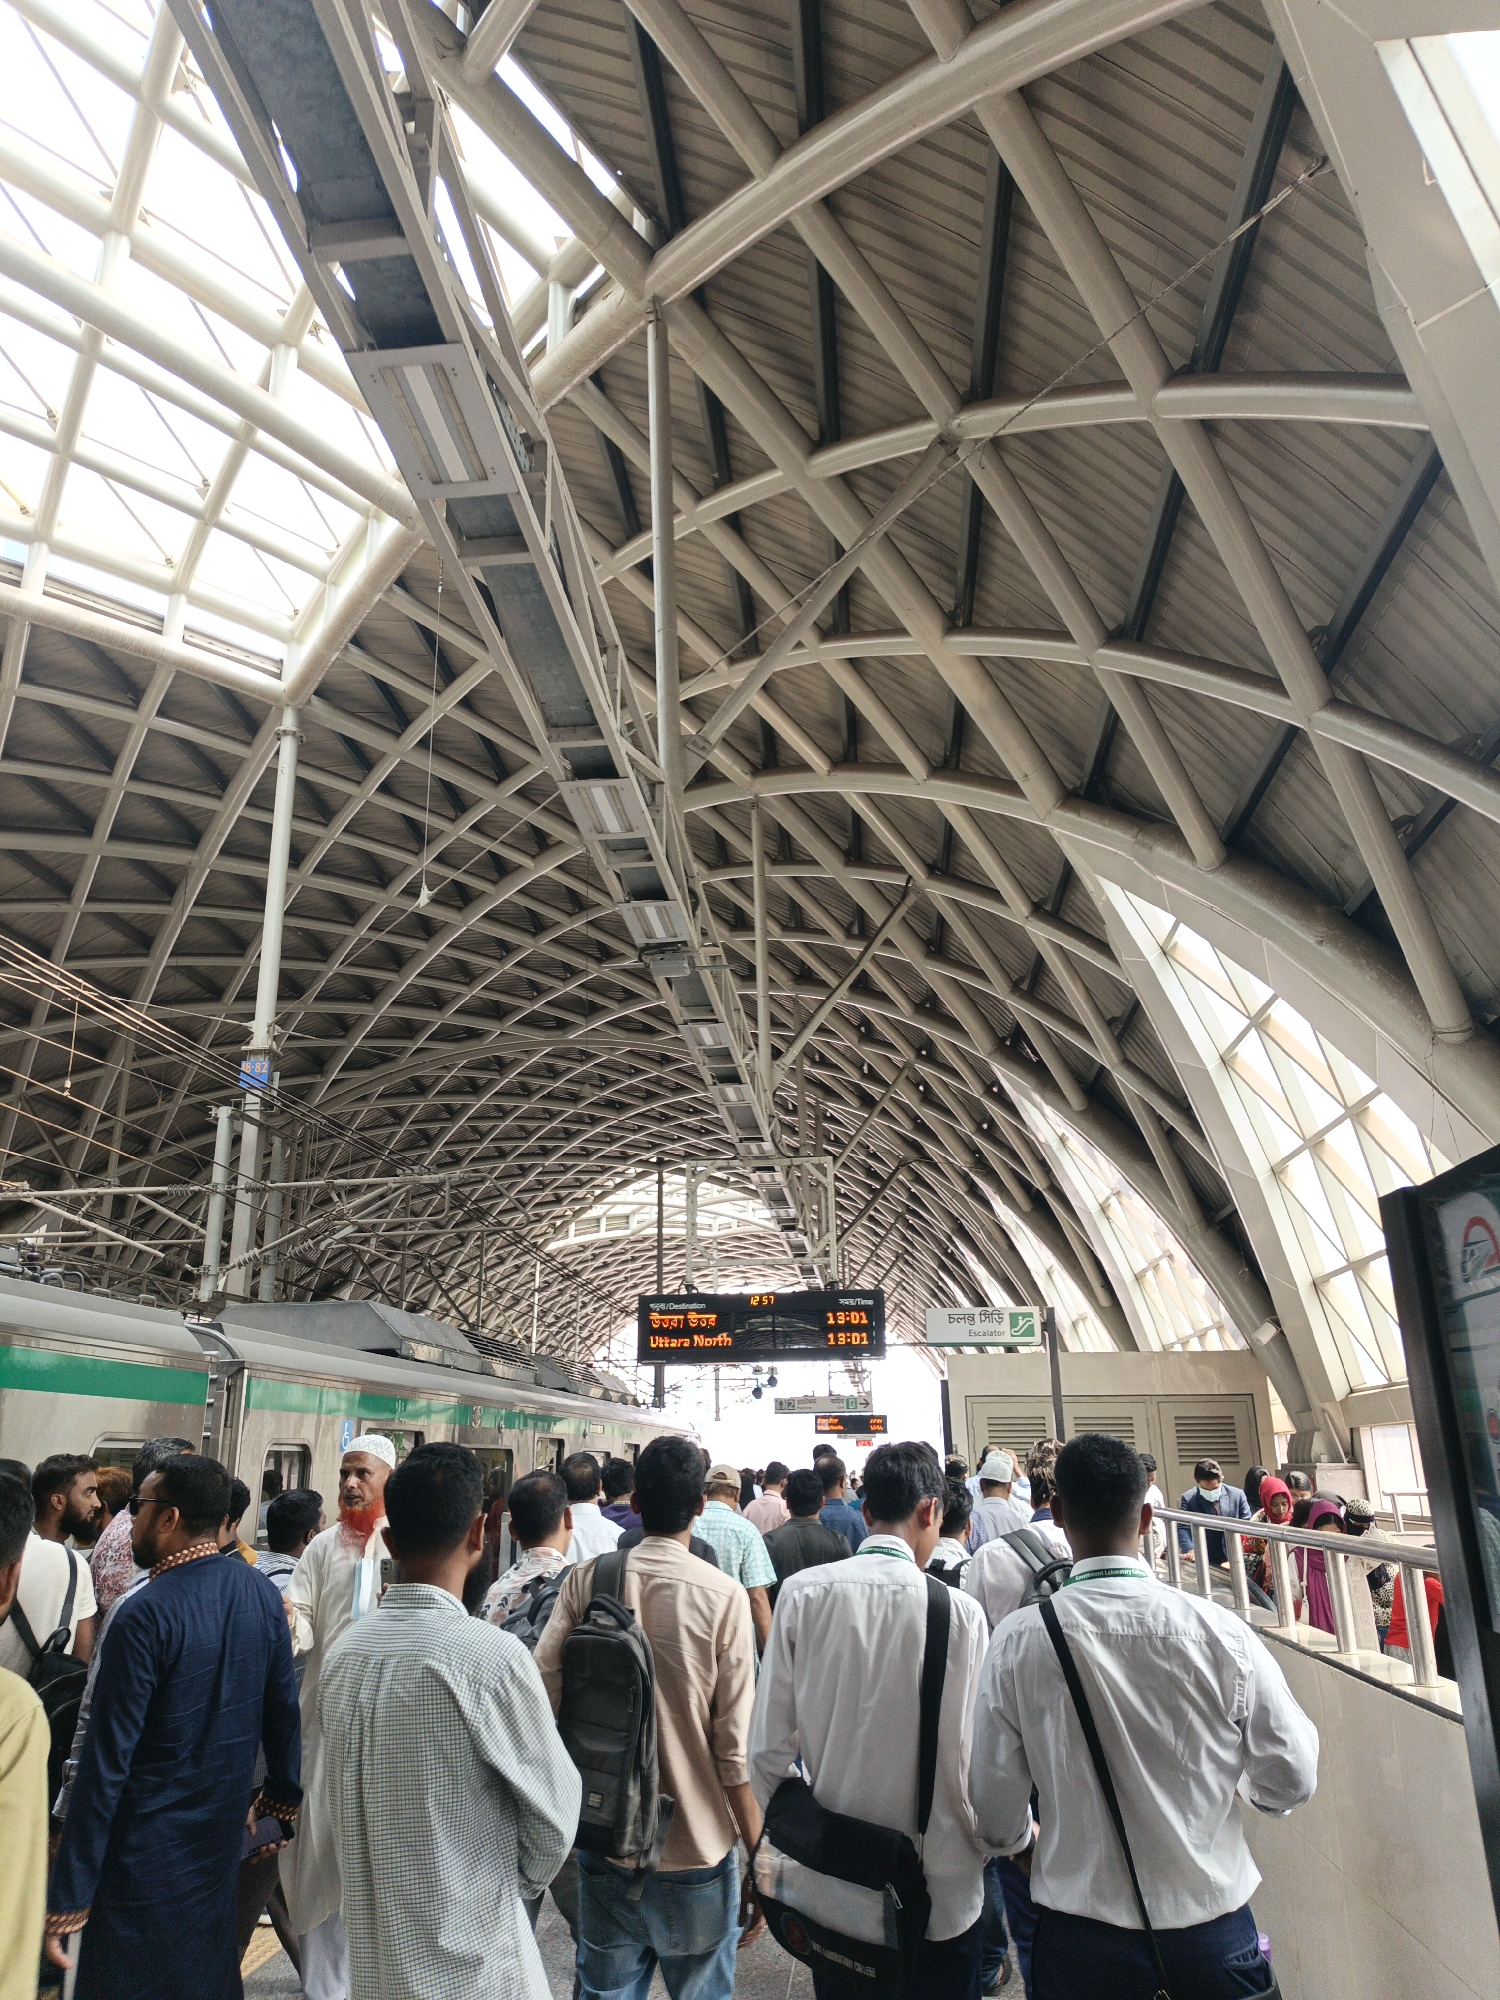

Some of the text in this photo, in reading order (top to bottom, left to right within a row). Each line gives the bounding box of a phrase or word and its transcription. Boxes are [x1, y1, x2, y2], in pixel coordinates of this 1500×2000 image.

[827, 1311, 868, 1324] 13:01
[947, 1313, 976, 1325] চলন্ত
[827, 1332, 869, 1345] 13:01
[968, 1329, 1006, 1337] Escalator
[649, 1332, 732, 1348] Uttara North
